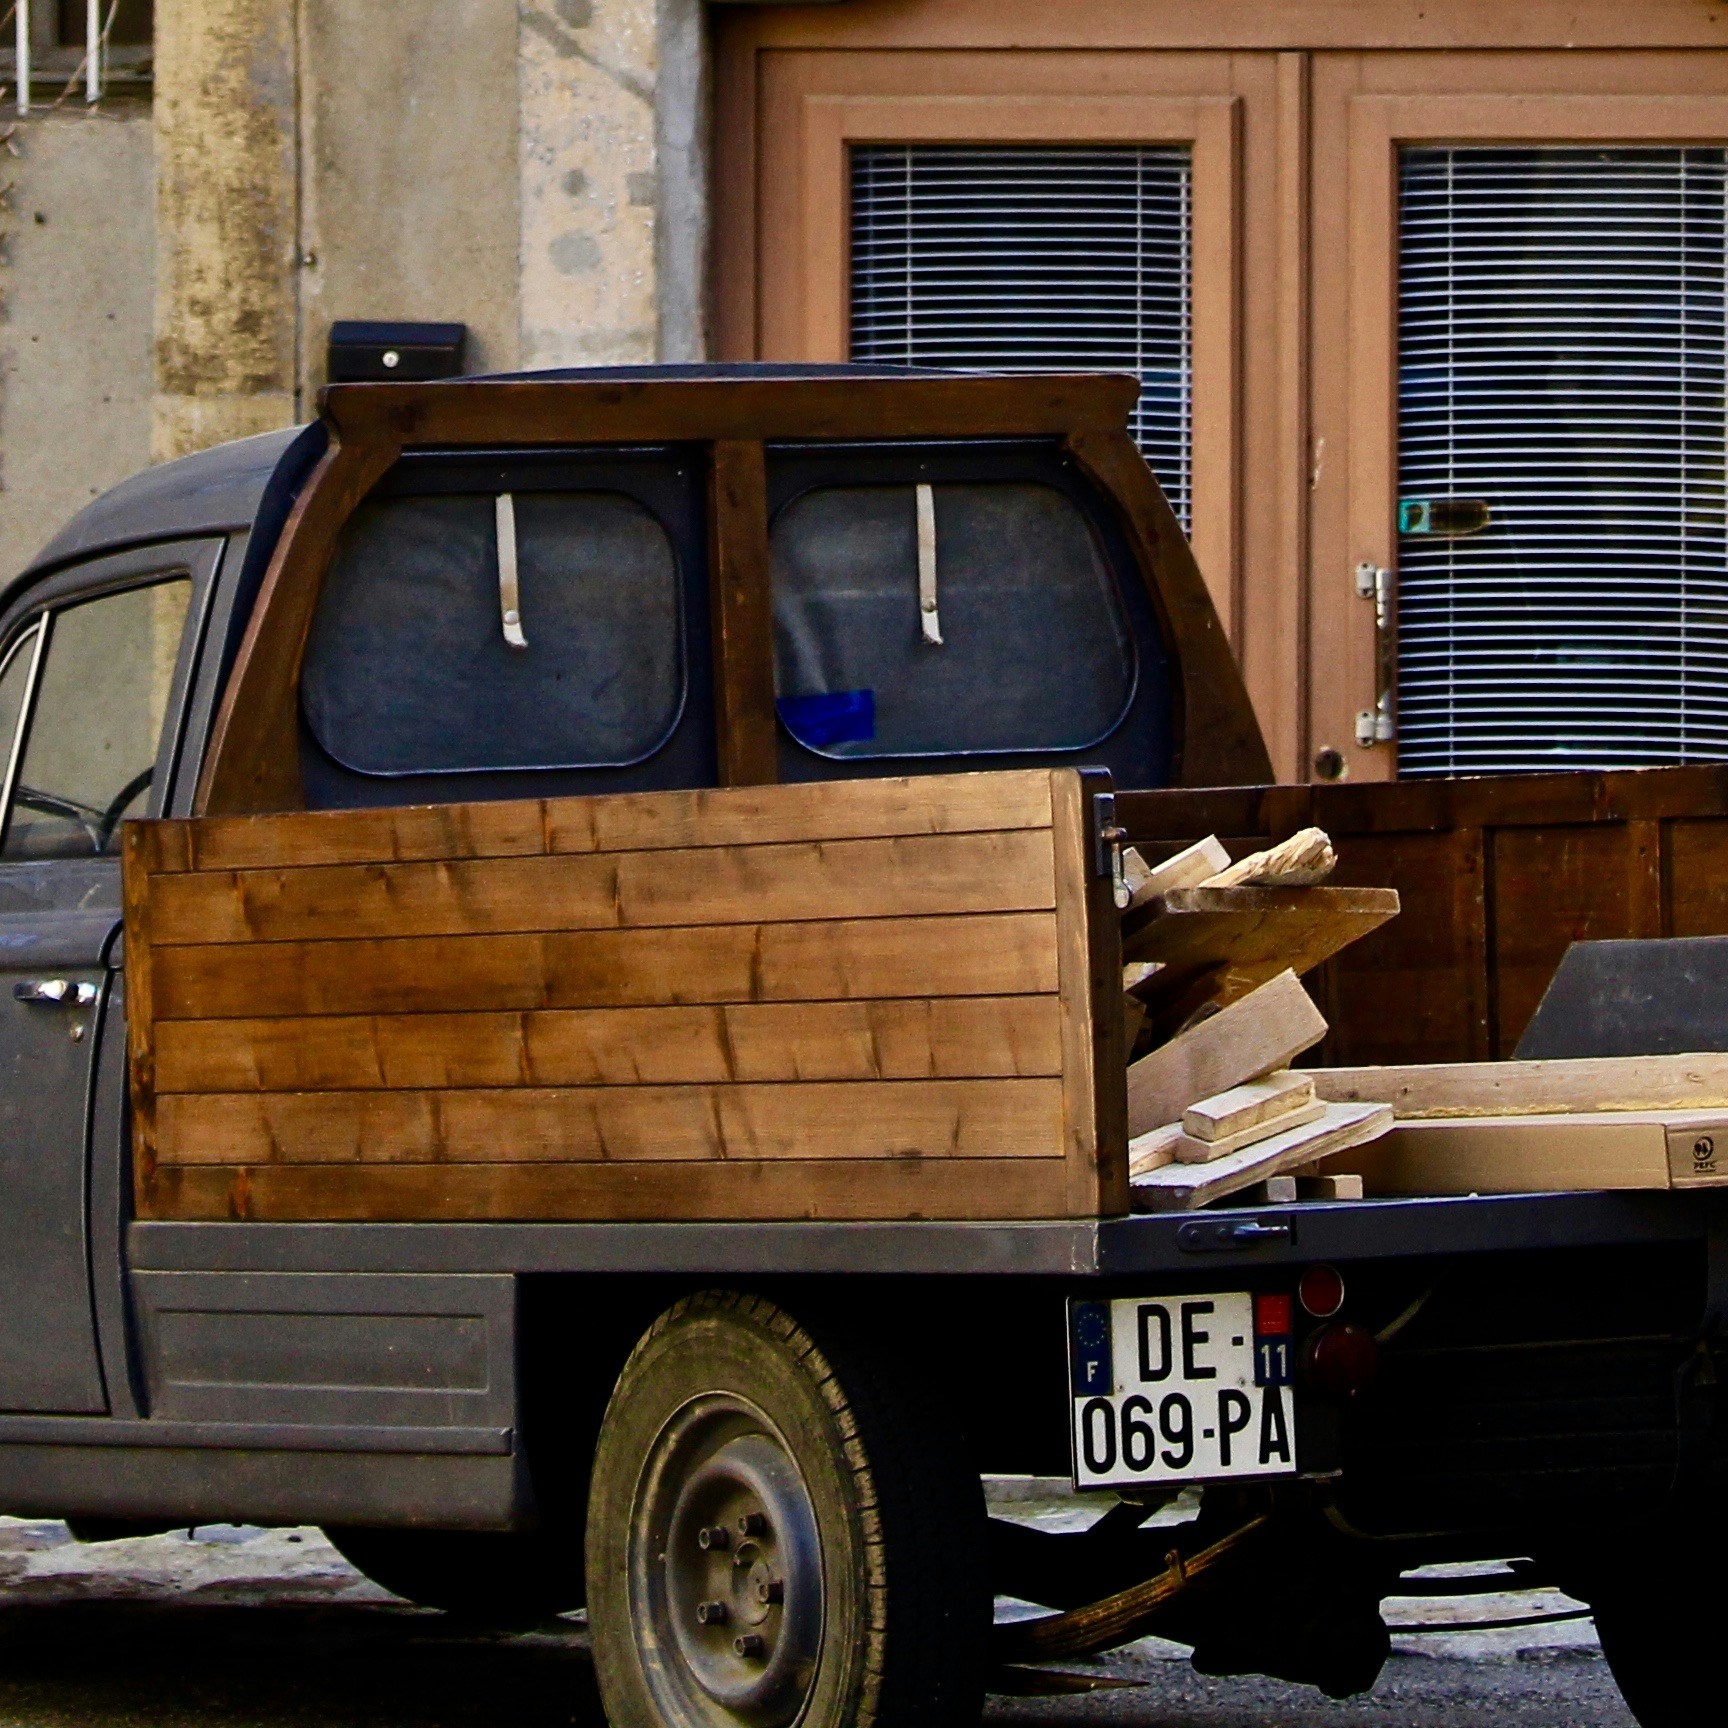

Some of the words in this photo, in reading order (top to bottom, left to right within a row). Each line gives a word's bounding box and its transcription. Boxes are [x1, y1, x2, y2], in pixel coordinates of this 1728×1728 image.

[1086, 1361, 1099, 1383] F
[1260, 1343, 1288, 1379] 11
[1081, 1386, 1291, 1475] 069-PA
